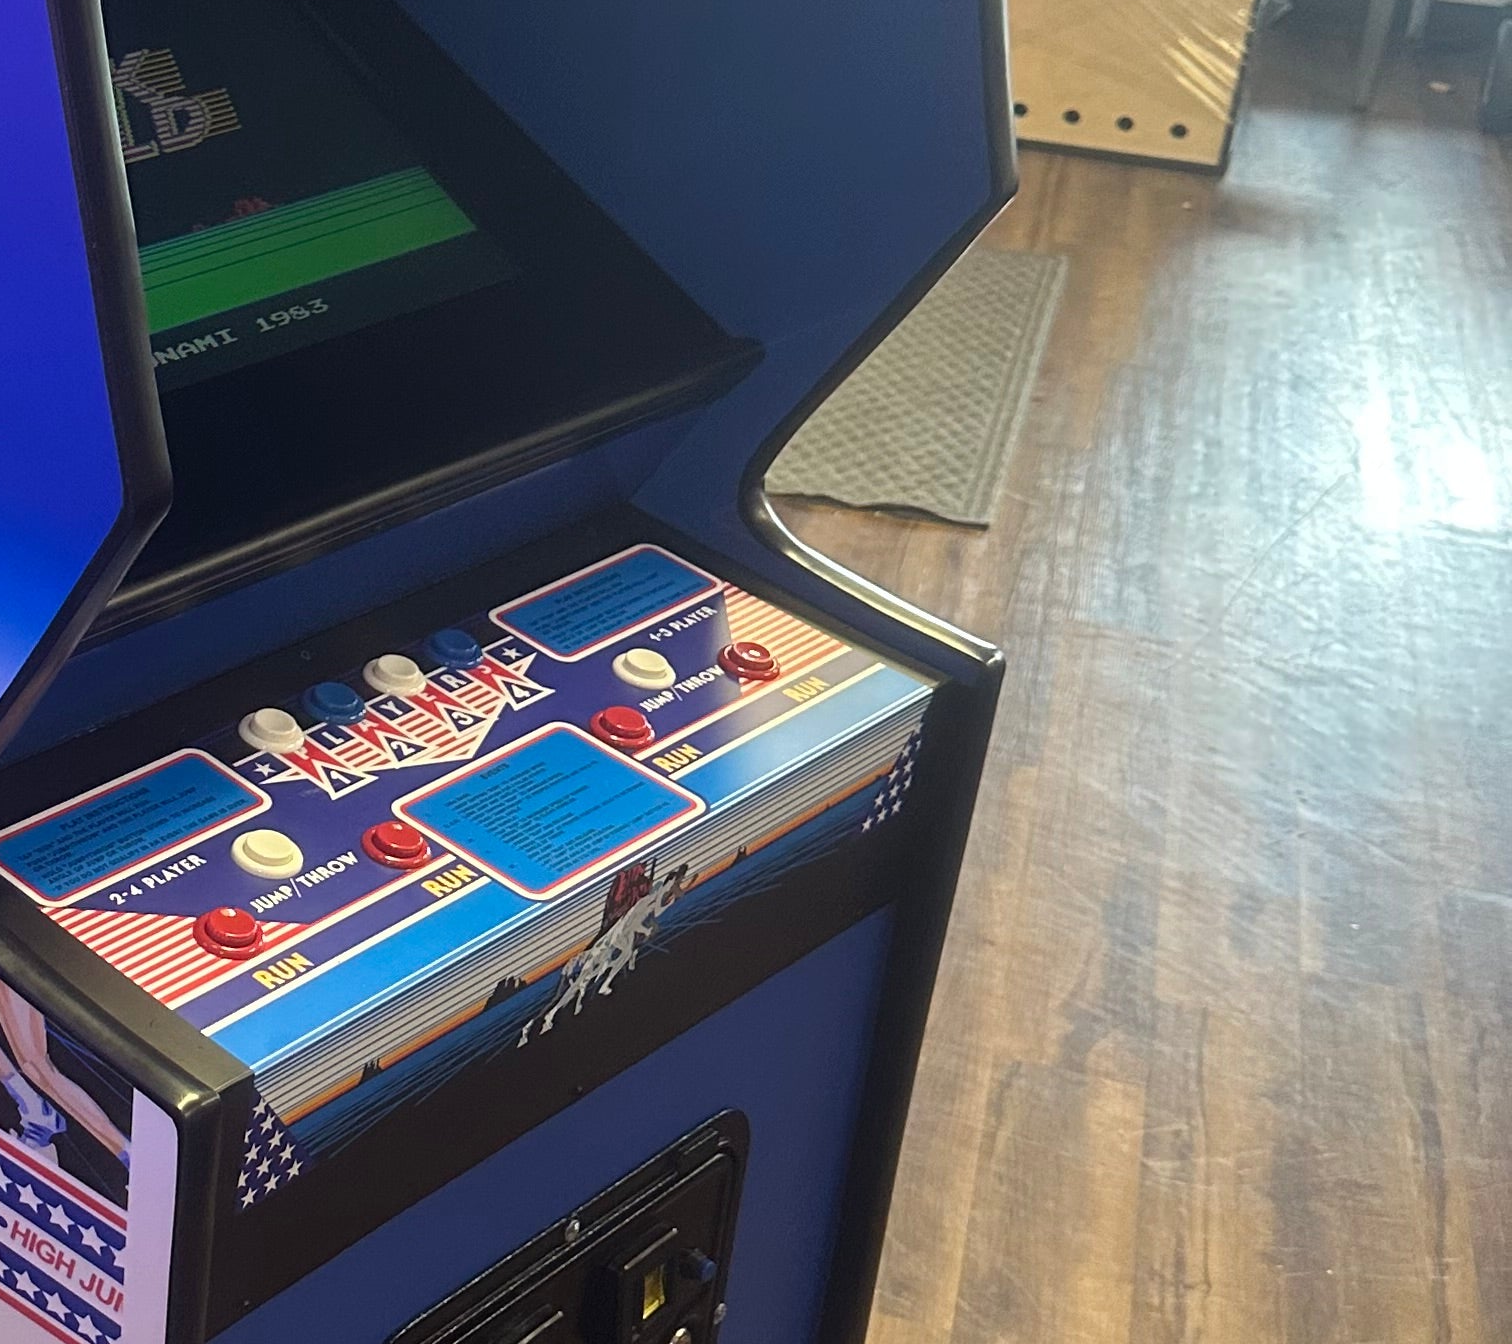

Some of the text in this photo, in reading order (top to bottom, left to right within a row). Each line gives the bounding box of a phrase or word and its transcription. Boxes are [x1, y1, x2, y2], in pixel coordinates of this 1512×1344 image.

[255, 298, 329, 333] 1983
[669, 606, 718, 631] PLAYER
[782, 676, 831, 702] RUN
[653, 744, 702, 773] RUN
[146, 853, 207, 889] PLAYER
[248, 850, 359, 913] JUMP/THROW
[422, 863, 479, 899] RUN
[252, 951, 315, 991] RUN
